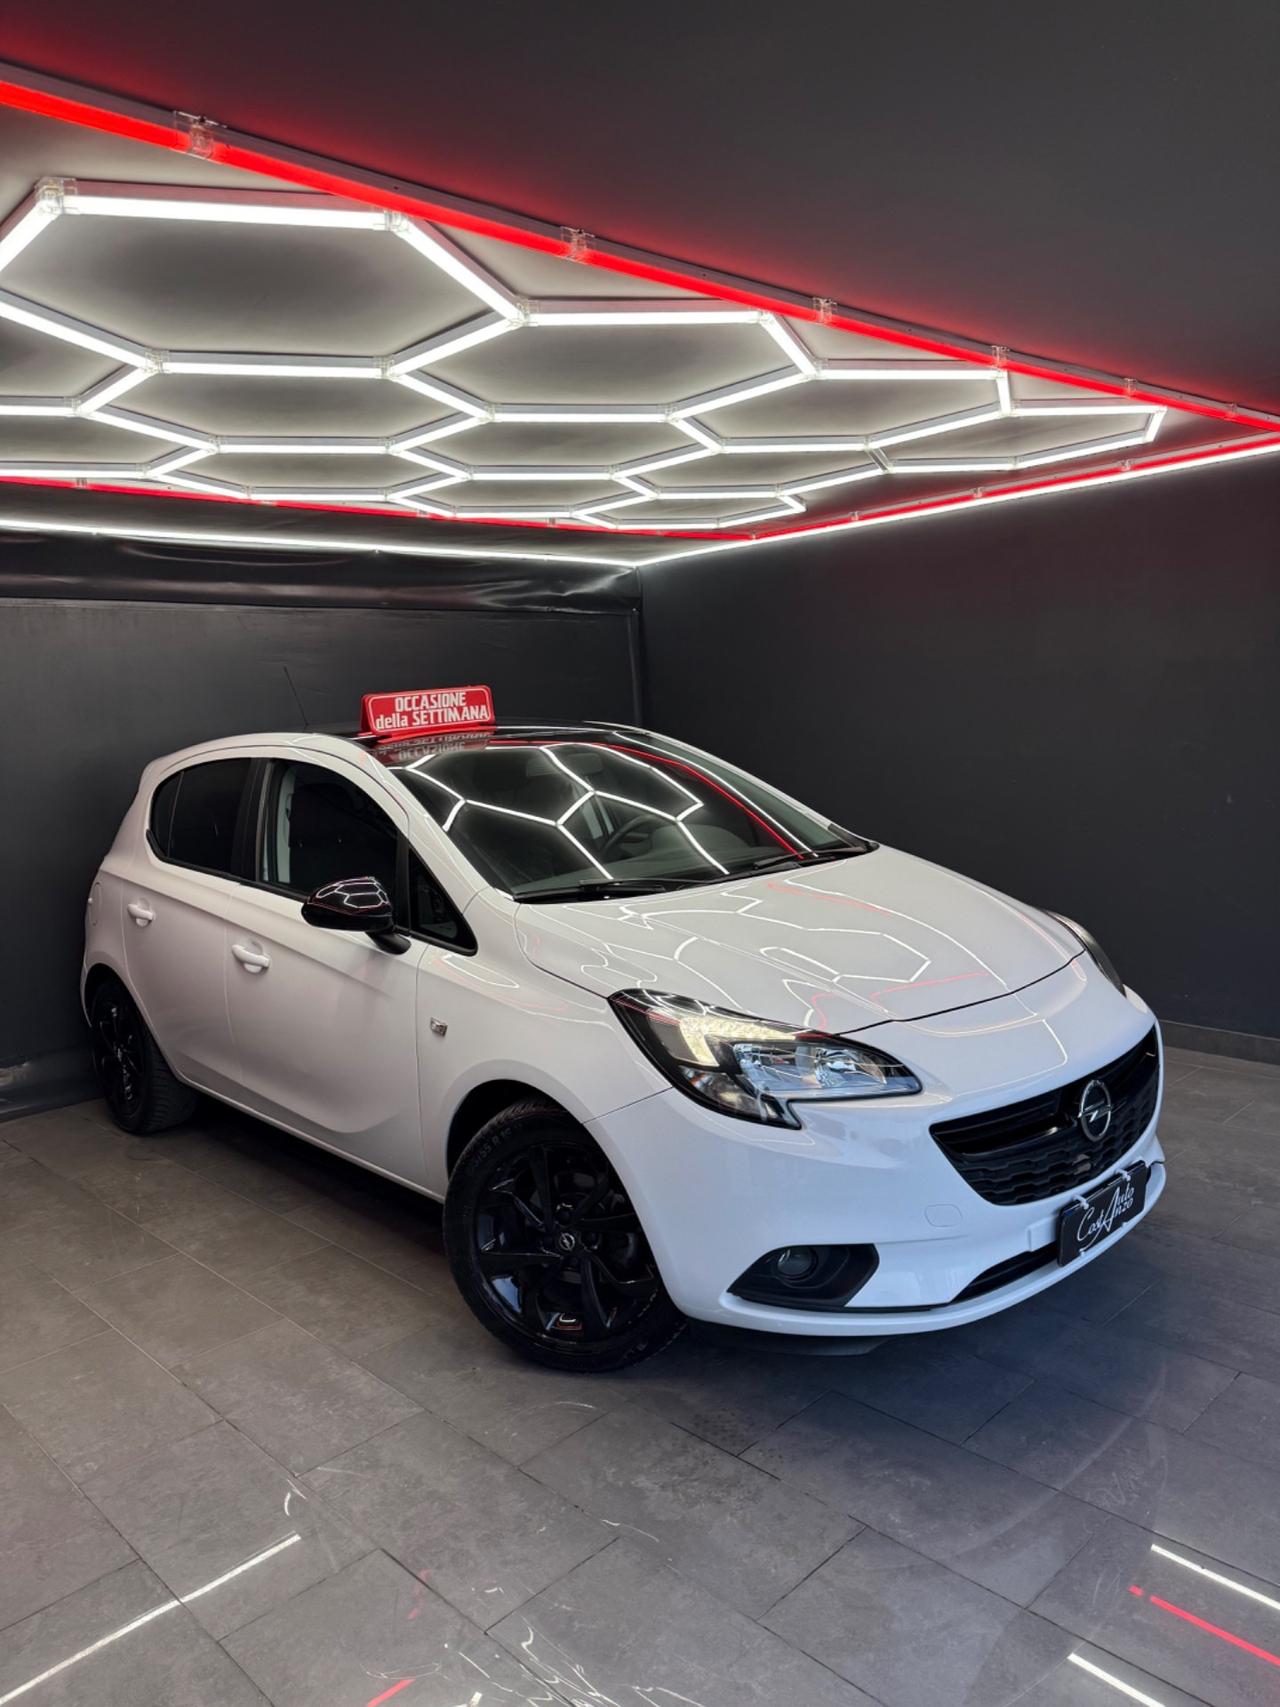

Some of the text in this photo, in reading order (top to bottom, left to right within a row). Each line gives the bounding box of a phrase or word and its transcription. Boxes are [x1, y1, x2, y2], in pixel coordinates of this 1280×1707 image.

[394, 691, 467, 713] OCCASIONE
[375, 704, 489, 730] della SETTIMANA
